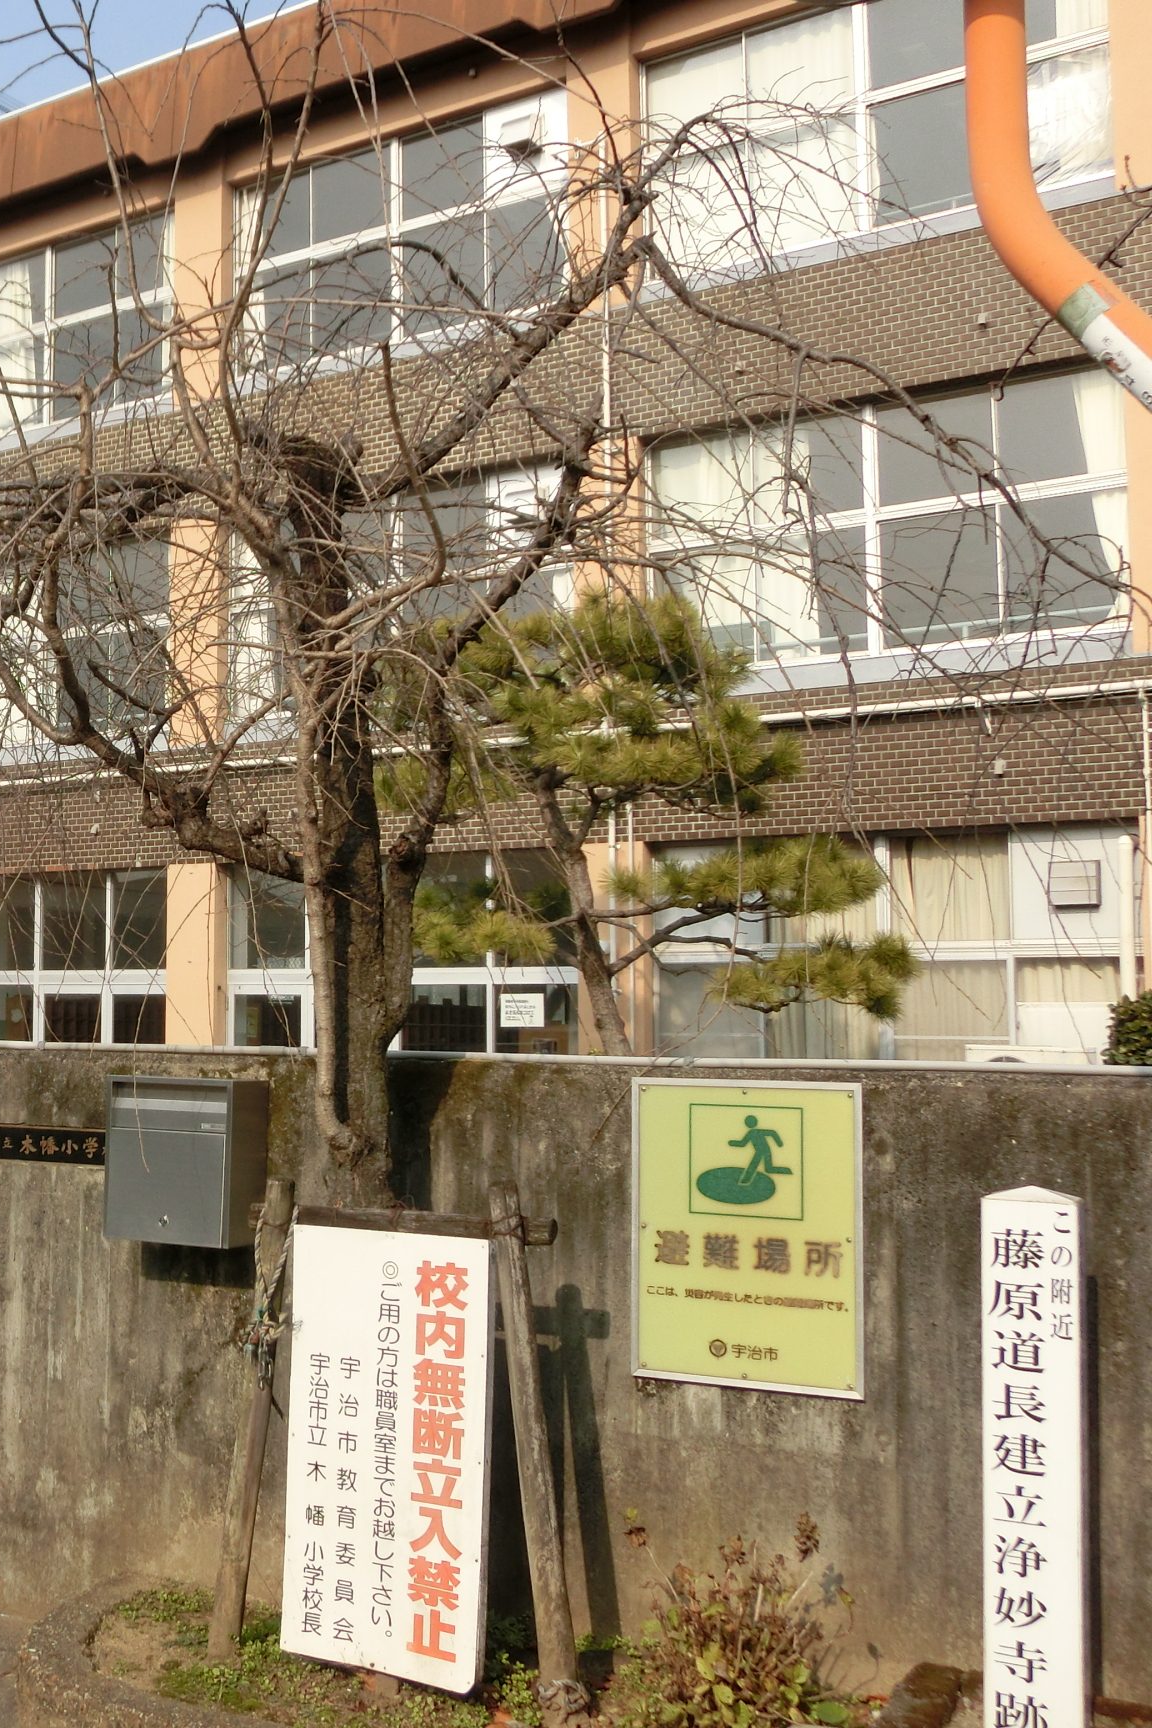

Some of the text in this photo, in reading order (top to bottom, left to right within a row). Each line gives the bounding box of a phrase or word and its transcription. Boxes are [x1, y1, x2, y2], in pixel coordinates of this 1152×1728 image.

[654, 1229, 843, 1279] 避難場所
[731, 1343, 779, 1361] 宇治市
[1050, 1211, 1074, 1341] この附近
[332, 1355, 361, 1643] 宇治市教育委員会
[406, 1260, 469, 1664] 校内無断立入禁止
[987, 1228, 1048, 1728] 藤原道長建立浄妙寺跡
